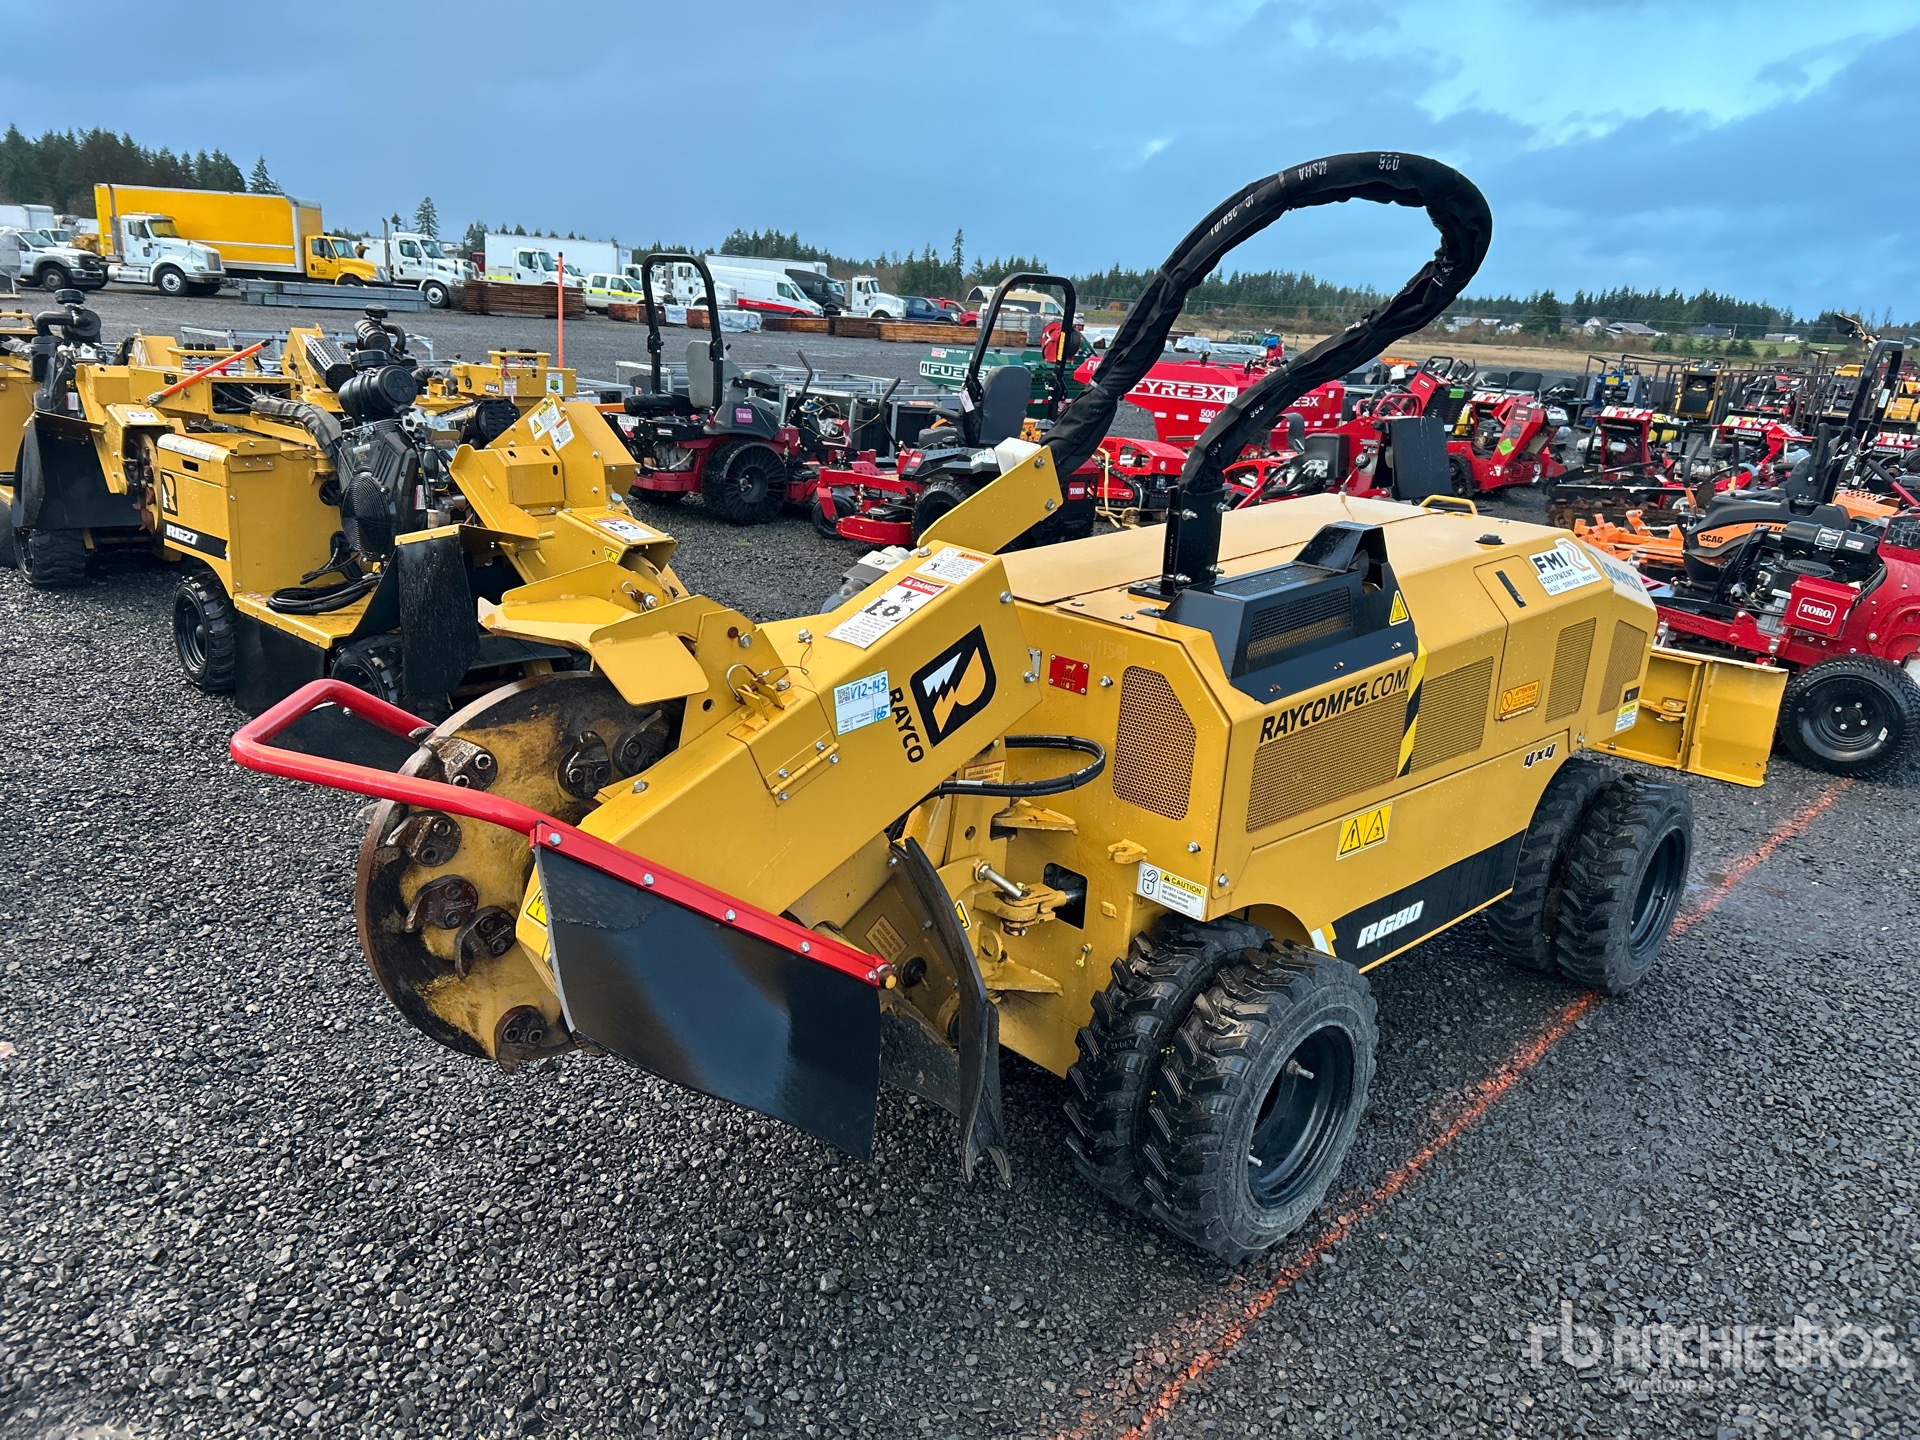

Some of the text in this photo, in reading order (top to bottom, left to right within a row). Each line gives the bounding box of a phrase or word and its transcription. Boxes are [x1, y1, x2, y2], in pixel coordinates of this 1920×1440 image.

[1226, 391, 1236, 400] T5
[1200, 409, 1216, 419] 500
[1069, 486, 1085, 495] TORO
[166, 523, 198, 545] RG27
[1700, 533, 1724, 544] SCAG
[1532, 551, 1569, 574] FMI
[1540, 569, 1575, 585] EQUIPMENT
[1546, 572, 1600, 594] SALES SERVICE RENTALS
[913, 580, 942, 593] DANGE
[1802, 603, 1832, 619] TORO
[1658, 613, 1708, 632] OMMERCIAL
[1259, 666, 1411, 743] RAYCOMFG.COM
[890, 686, 925, 763] RAYCO
[1171, 877, 1202, 895] CAUTION
[1356, 900, 1425, 950] RG80
